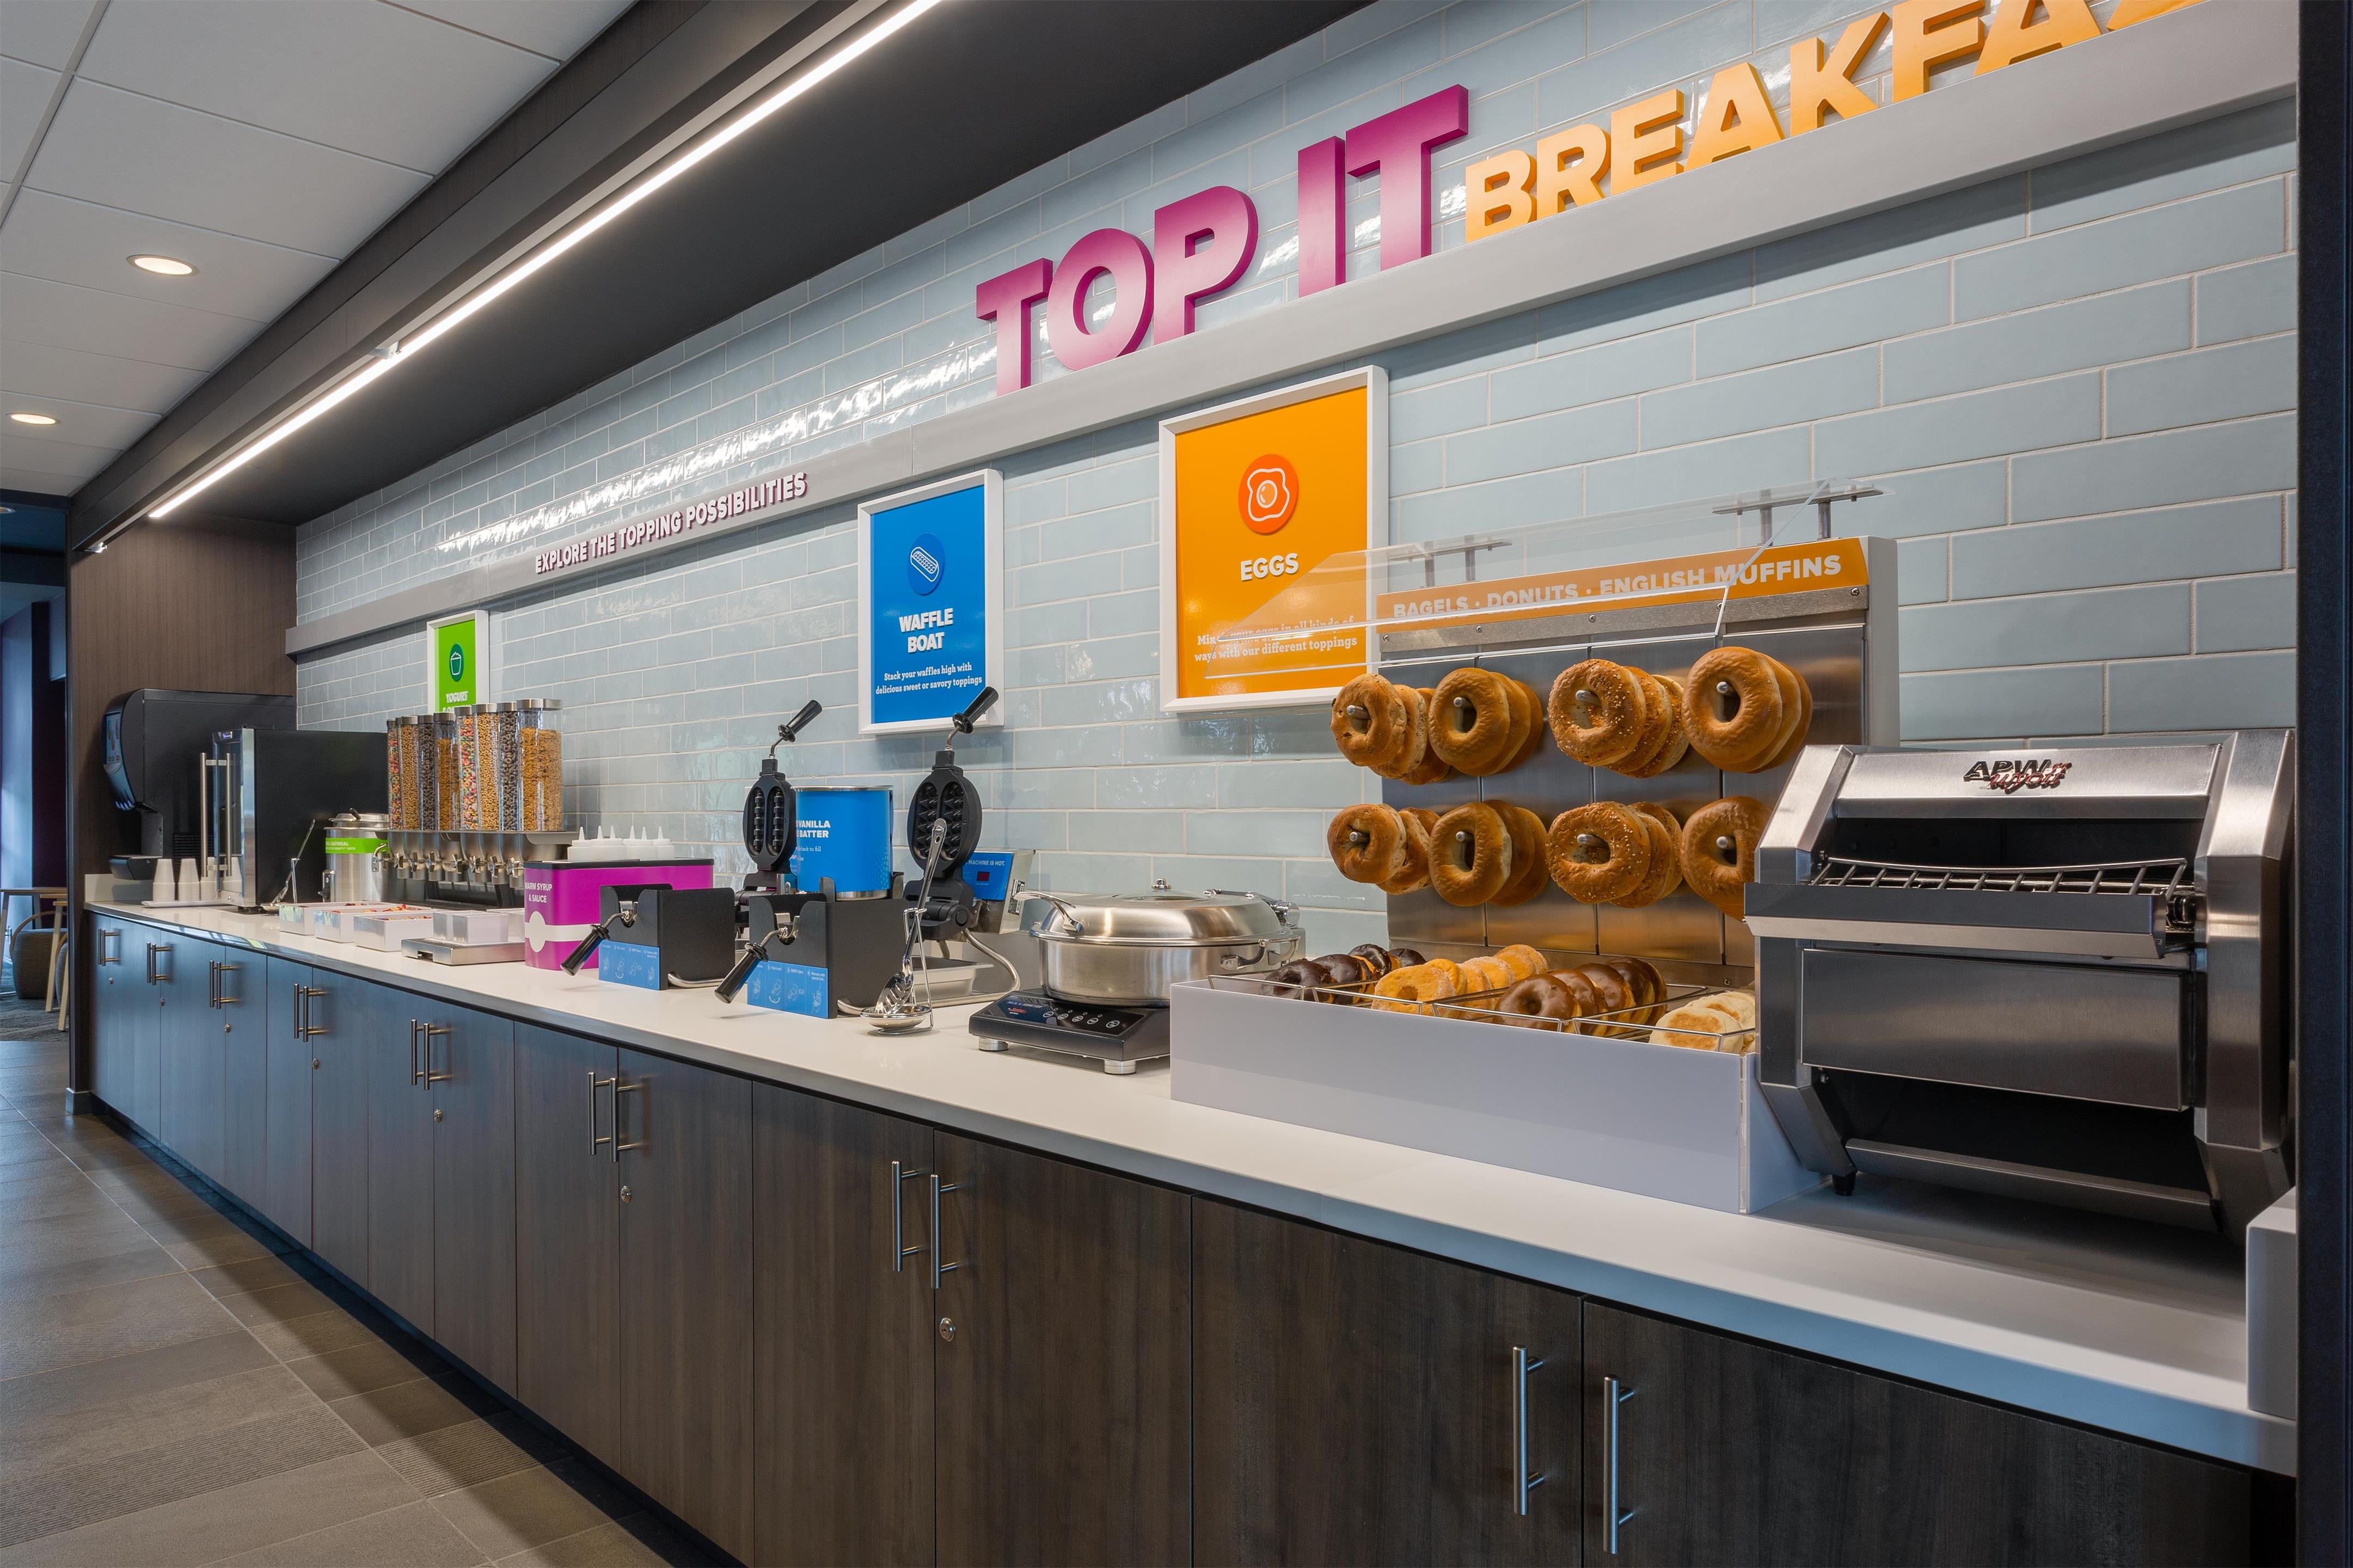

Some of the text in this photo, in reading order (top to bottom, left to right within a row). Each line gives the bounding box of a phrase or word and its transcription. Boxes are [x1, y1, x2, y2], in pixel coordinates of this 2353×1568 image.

[976, 0, 2206, 396] TOP IT BREAKFA
[536, 472, 807, 574] EXPLORE THE TOPPING POSSIBILITIES
[1240, 553, 1299, 581] EGGS
[1394, 555, 1841, 618] BAGELS DONUTS ENGLISH MUFFINS
[899, 608, 953, 632] WAFFLE
[908, 632, 945, 653] BOAT
[1194, 636, 1358, 663] ways with our different toppings
[884, 661, 972, 681] Stack your waffles high with
[875, 684, 902, 695] delicious
[903, 683, 921, 691] sweet
[930, 679, 952, 688] savory
[953, 676, 983, 688] toppings
[446, 691, 469, 703] YOGURT
[1963, 759, 2052, 782] APW
[799, 820, 831, 828] VANILLA
[799, 830, 829, 838] BATTER
[536, 883, 553, 891] SYRUP
[528, 893, 547, 903] & SAUCE
